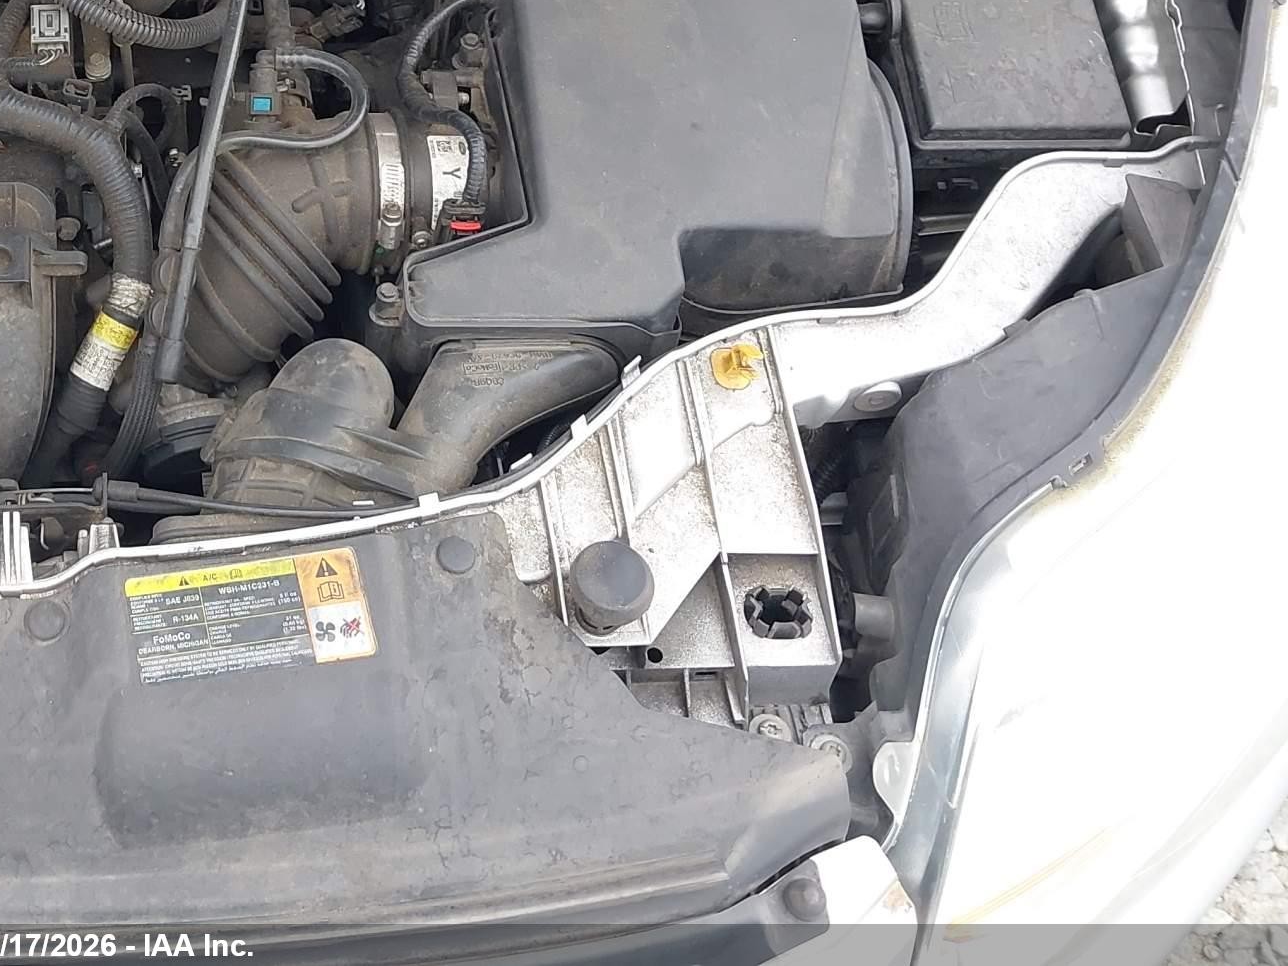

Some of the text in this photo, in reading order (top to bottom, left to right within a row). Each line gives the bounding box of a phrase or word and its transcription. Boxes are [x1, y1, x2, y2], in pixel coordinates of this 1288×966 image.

[202, 573, 218, 582] A/C
[172, 613, 199, 624] R-134A
[152, 631, 191, 645] FoMoCo
[138, 644, 177, 655] DEARBORN,
